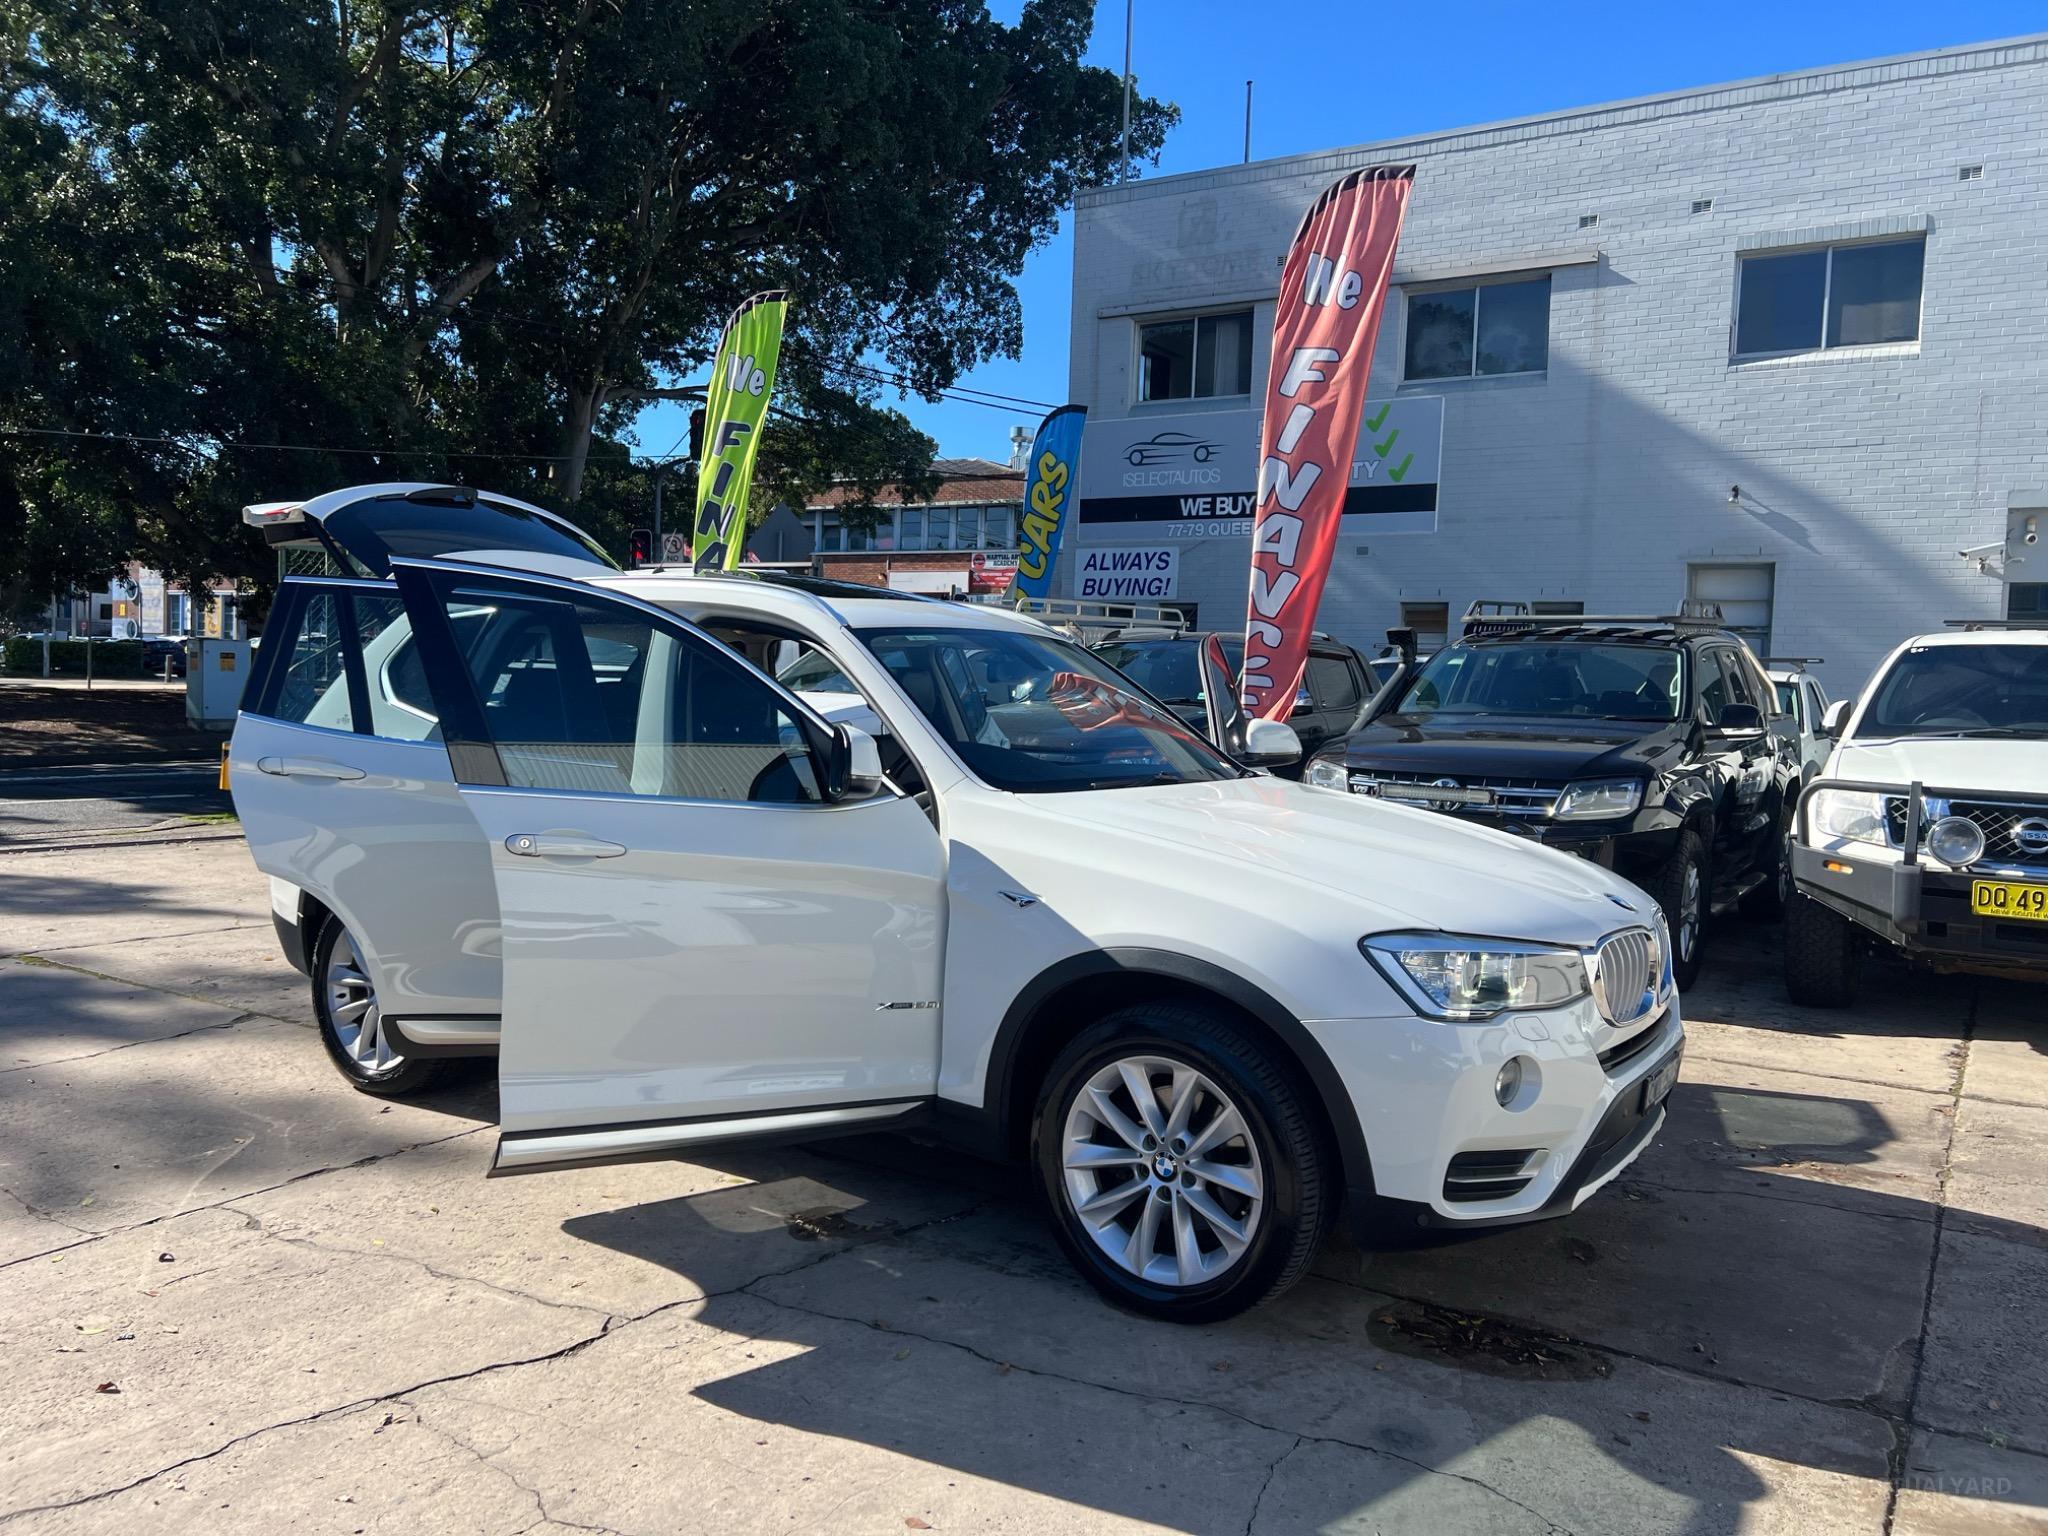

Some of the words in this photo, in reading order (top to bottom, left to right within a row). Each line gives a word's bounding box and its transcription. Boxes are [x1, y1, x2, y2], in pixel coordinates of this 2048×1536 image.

[1304, 252, 1363, 310] We
[725, 352, 767, 397] We
[1018, 450, 1070, 580] CARS
[1180, 497, 1212, 517] WE
[1215, 495, 1256, 516] BUY
[1167, 523, 1205, 537] 77-79
[666, 554, 679, 562] NO
[1083, 551, 1171, 572] ALWAYS
[1082, 577, 1171, 597] BUYING!
